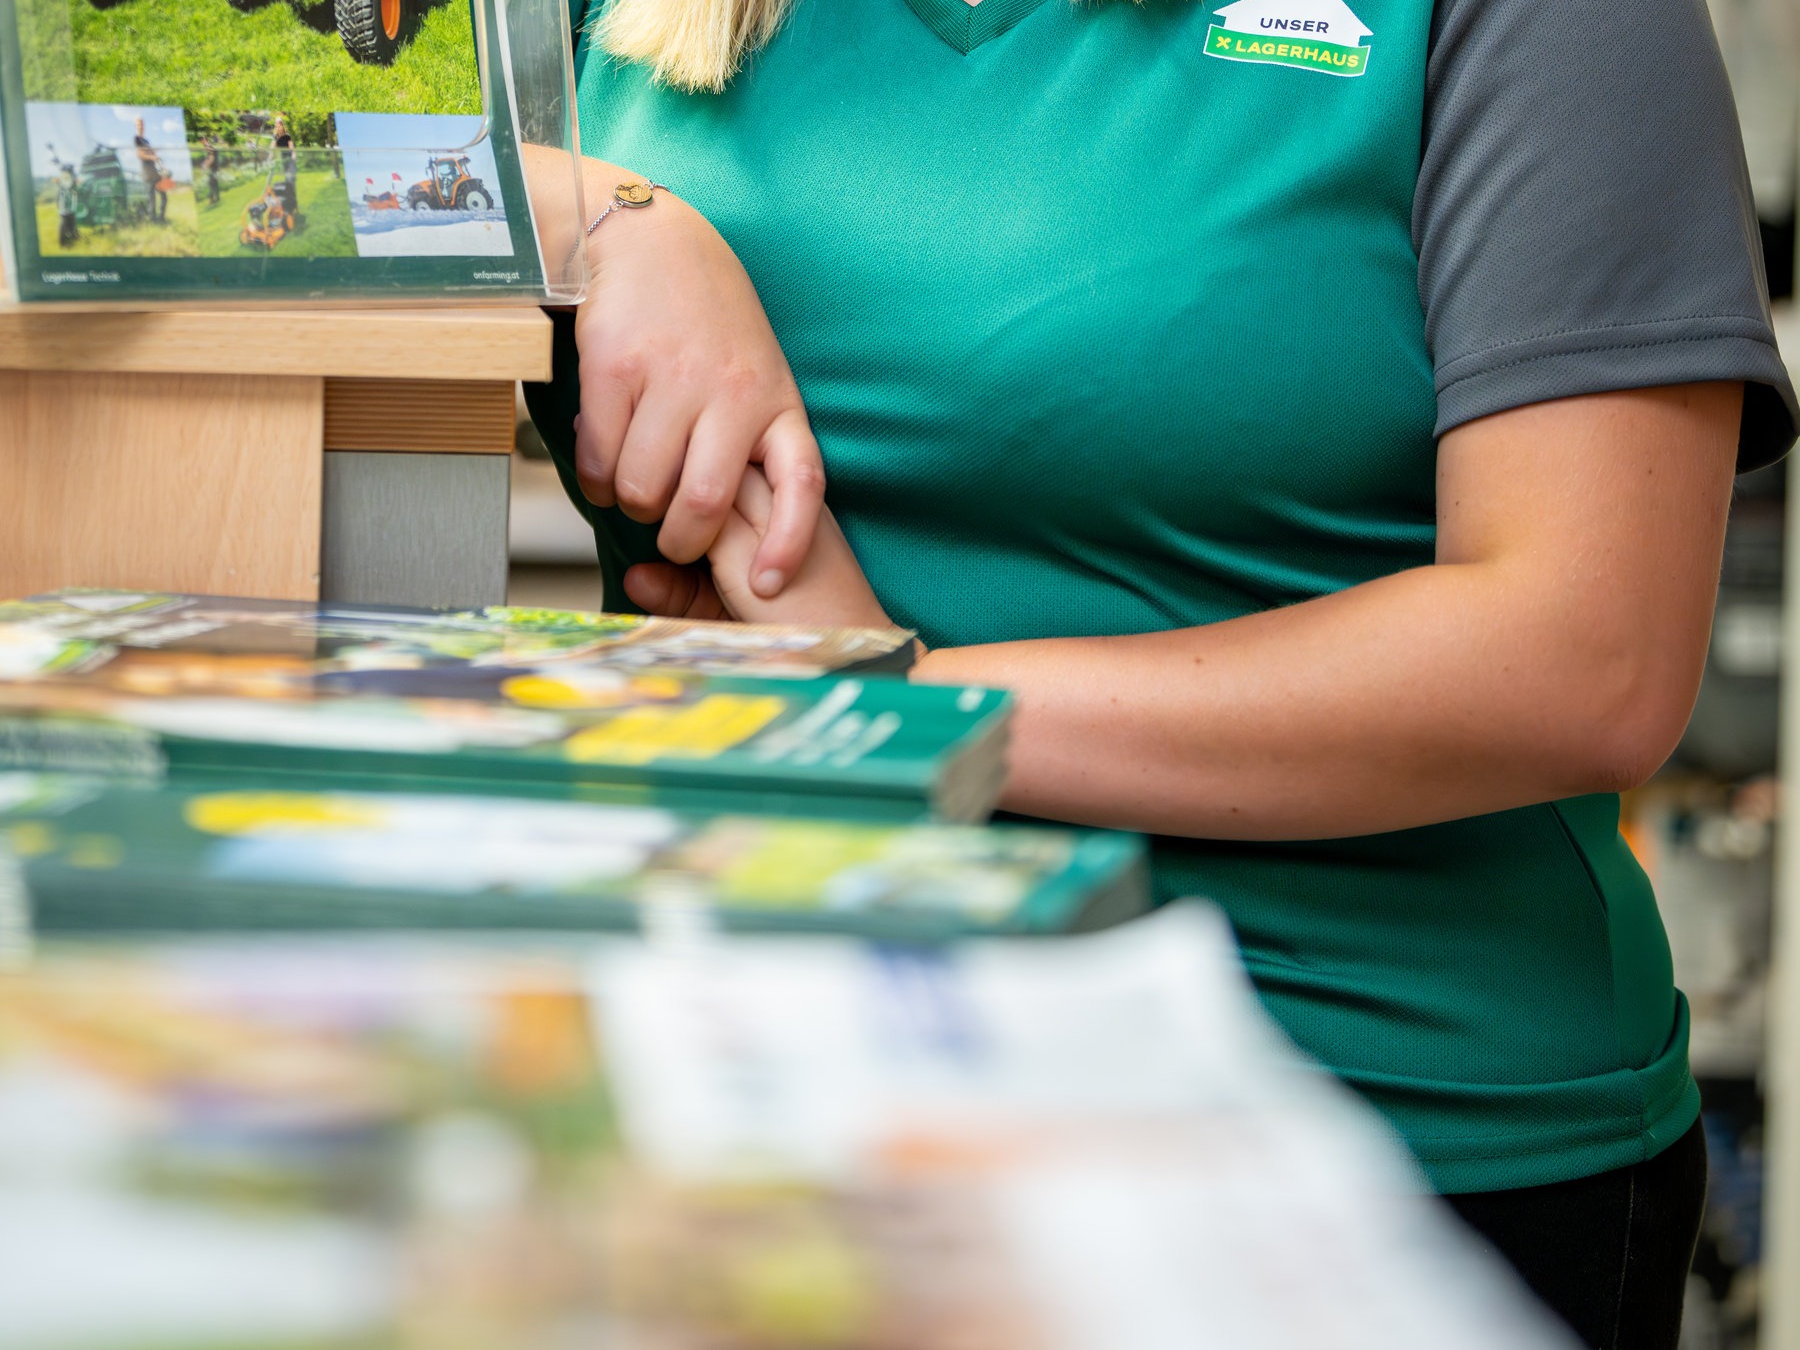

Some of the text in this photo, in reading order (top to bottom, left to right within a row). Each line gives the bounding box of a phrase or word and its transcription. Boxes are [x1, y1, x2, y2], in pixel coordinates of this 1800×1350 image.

[1260, 17, 1330, 34] UNSER
[1235, 39, 1359, 67] LAGERHAUS
[472, 270, 521, 284] onfarming.at
